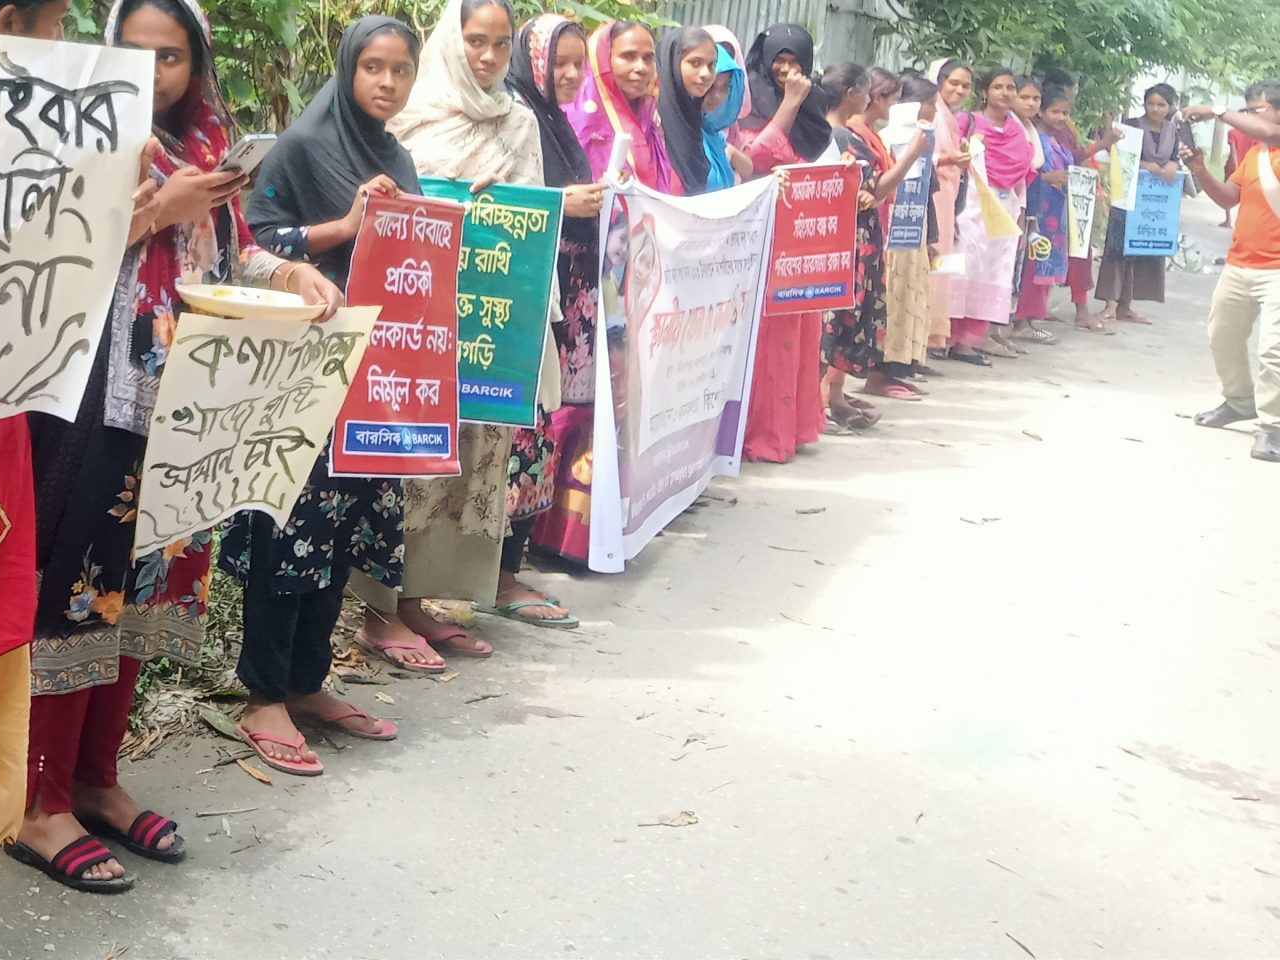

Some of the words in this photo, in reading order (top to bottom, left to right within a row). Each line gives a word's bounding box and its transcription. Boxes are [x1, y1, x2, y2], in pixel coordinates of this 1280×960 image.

[374, 210, 410, 240] বাল্য
[412, 207, 453, 250] বিবাহে
[475, 241, 512, 275] রাখি
[384, 257, 432, 298] প্রতিকী
[815, 286, 842, 296] BARCIK
[367, 364, 411, 412] নির্মূল
[415, 379, 440, 406] কর
[461, 383, 513, 398] BARCIK
[355, 428, 401, 446] বারসিক
[412, 433, 443, 445] BARCIK
